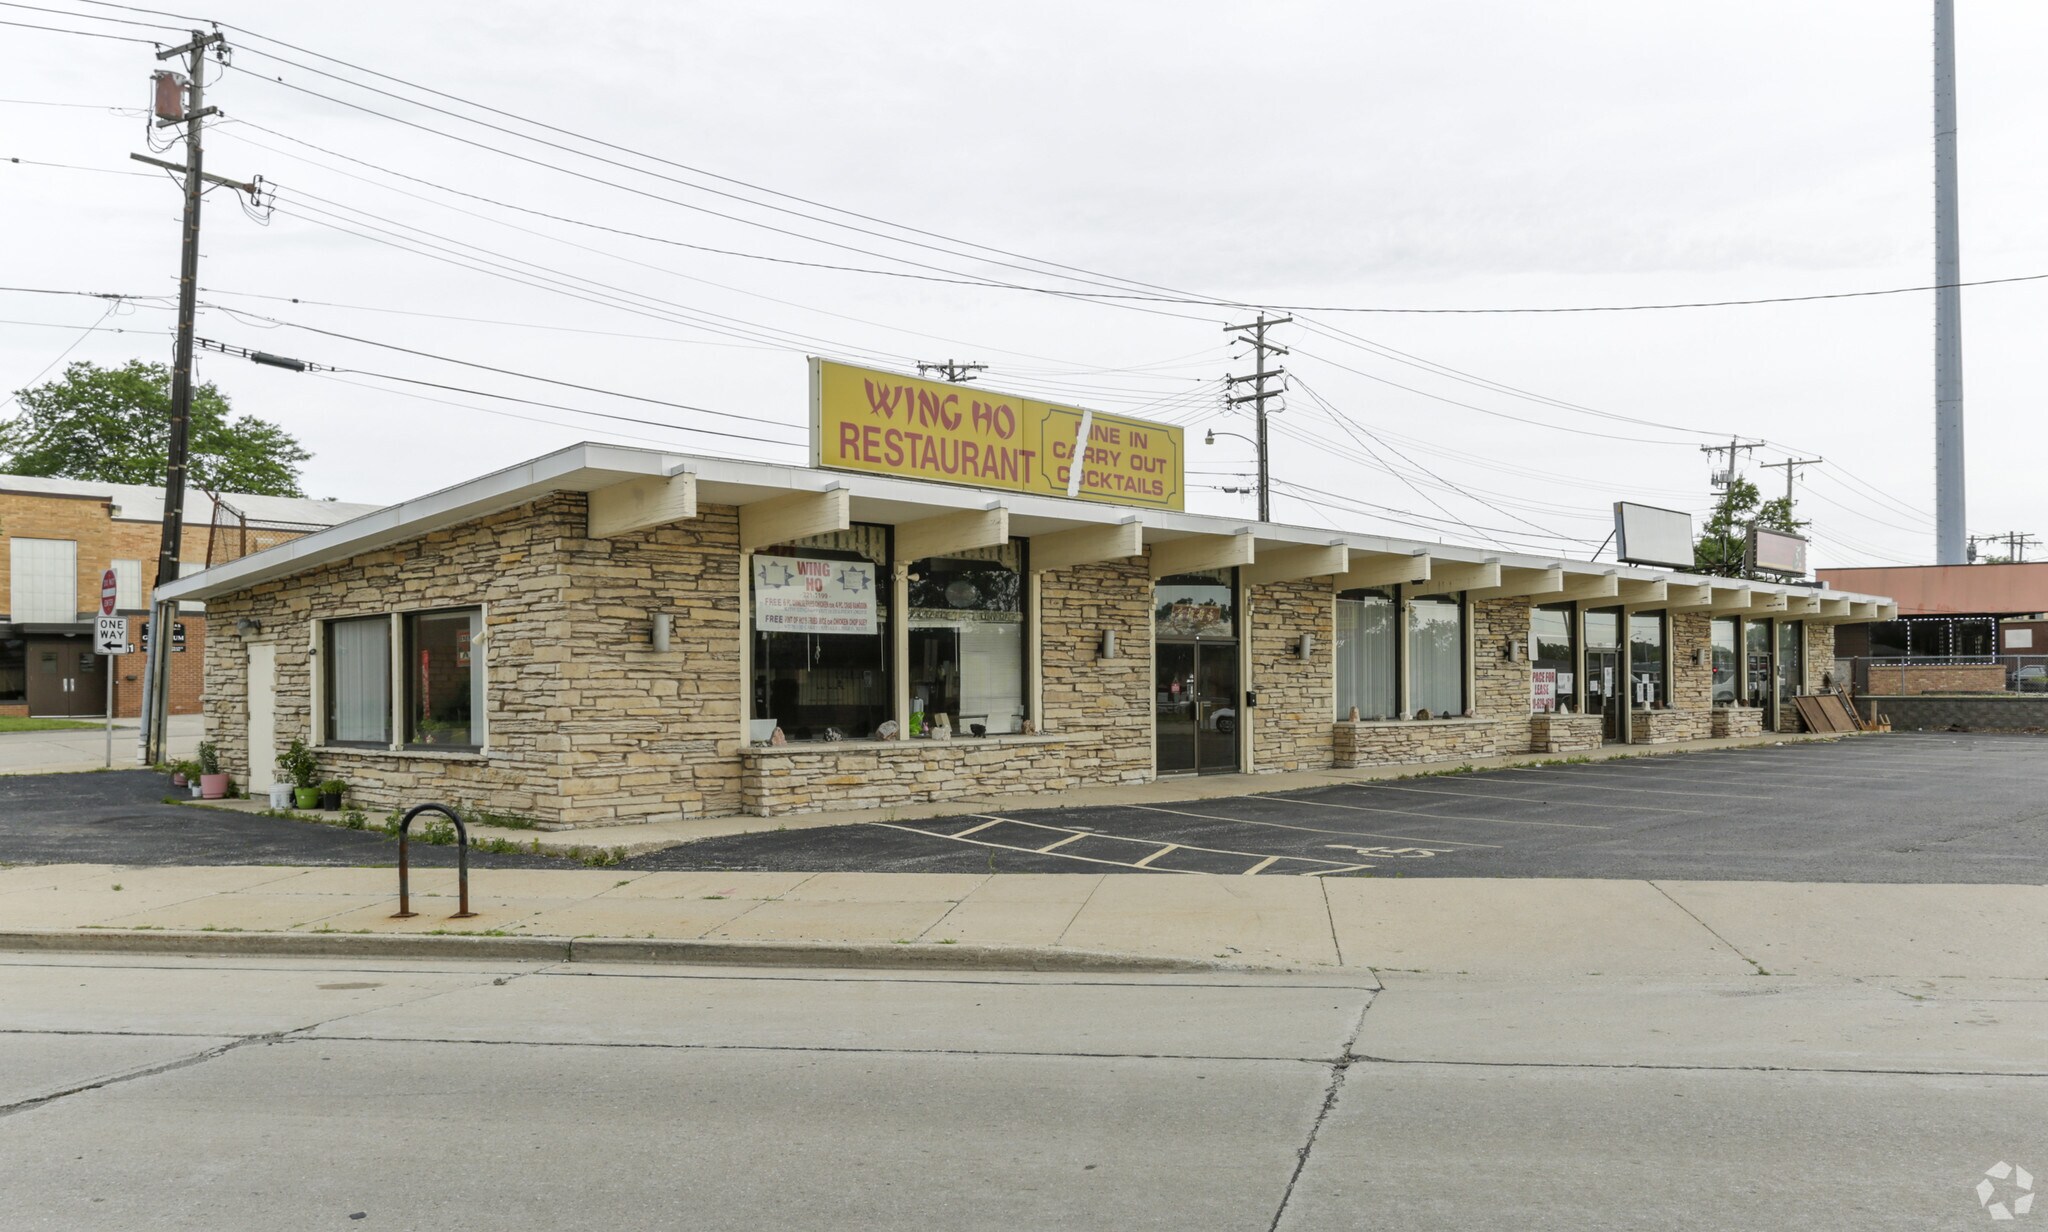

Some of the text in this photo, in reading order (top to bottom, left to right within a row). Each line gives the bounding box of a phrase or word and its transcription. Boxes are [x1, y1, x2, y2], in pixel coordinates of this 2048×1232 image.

[863, 377, 1016, 440] WING HO
[1129, 431, 1148, 450] IN
[839, 421, 1036, 484] RESTAURANT
[1130, 454, 1167, 475] OUT
[797, 561, 830, 577] WING
[806, 577, 822, 592] HO
[765, 598, 782, 606] FREE
[100, 620, 124, 629] ONE
[765, 615, 783, 624] FREE
[100, 630, 125, 639] WAY
[1546, 672, 1554, 683] FOR
[1535, 684, 1549, 695] LEASE
